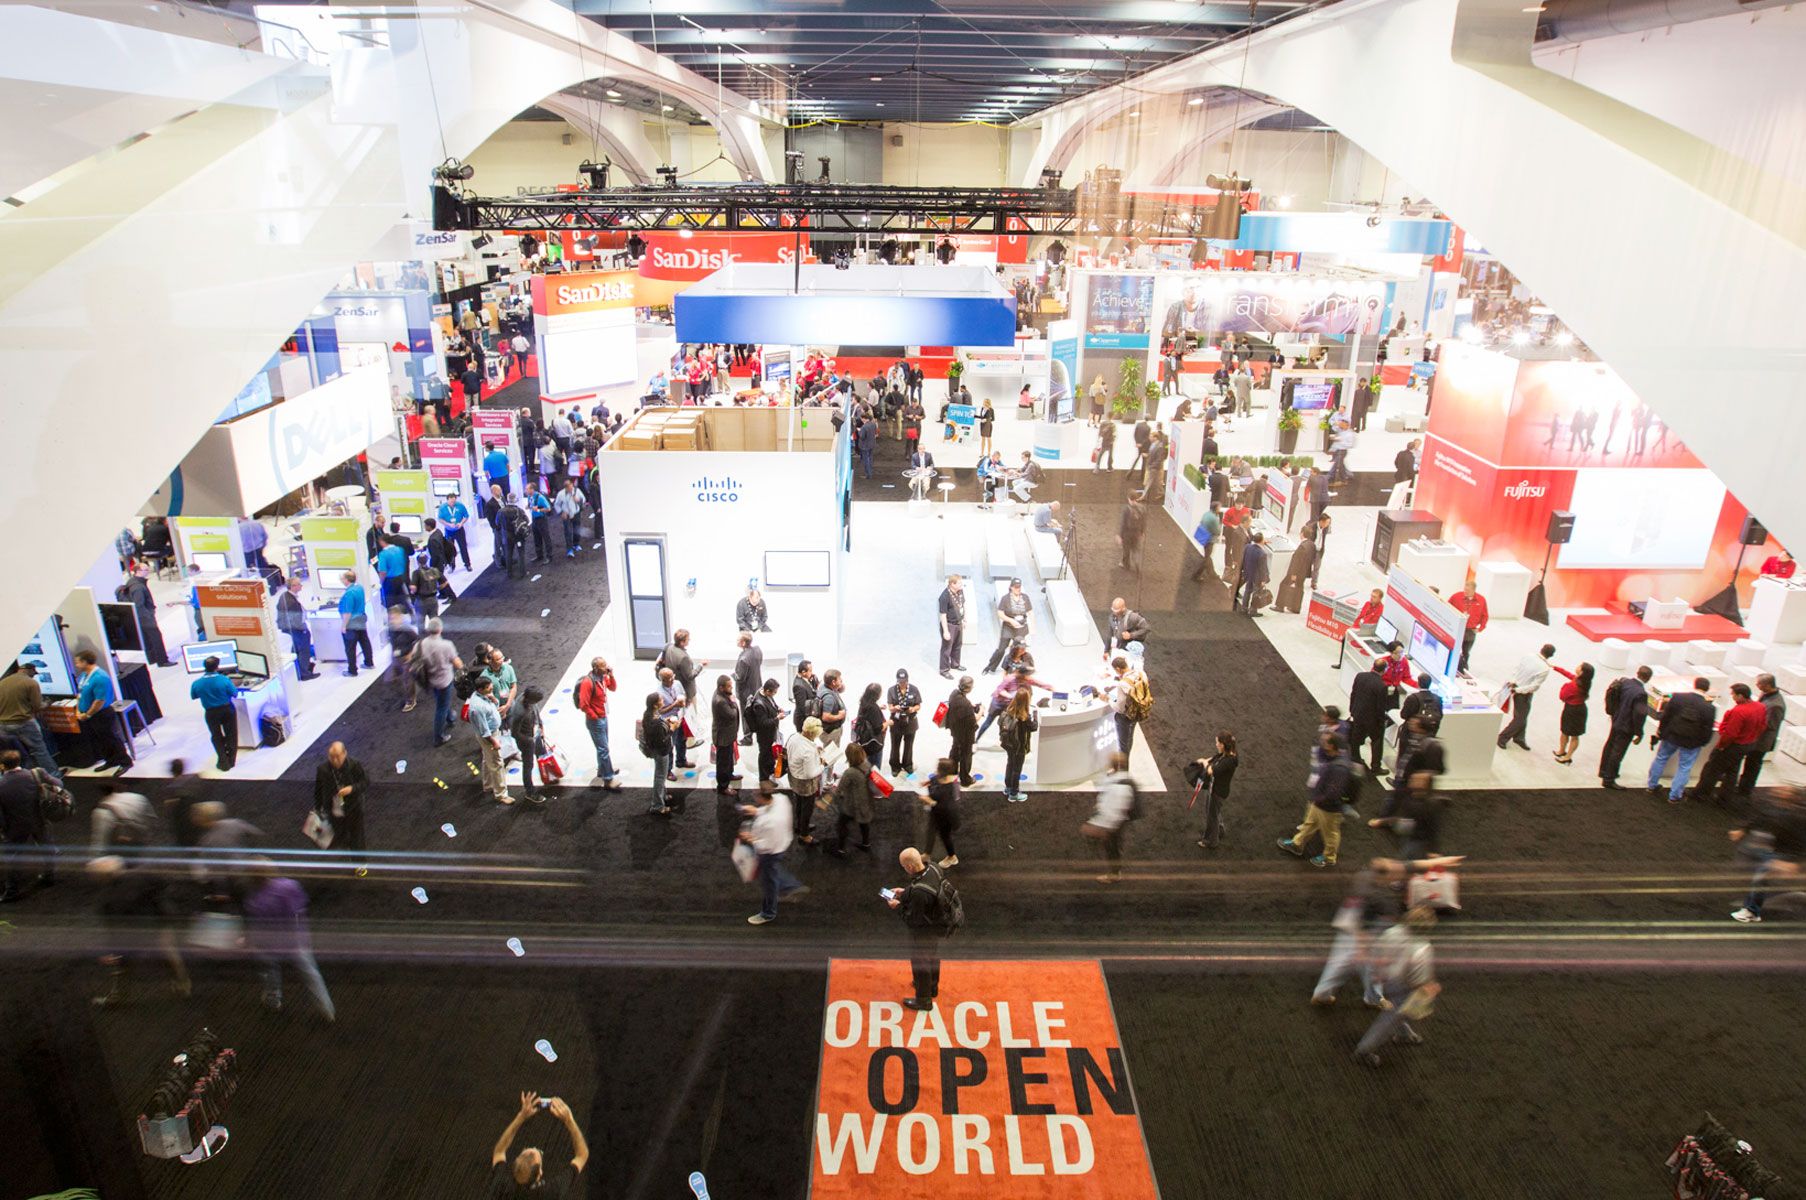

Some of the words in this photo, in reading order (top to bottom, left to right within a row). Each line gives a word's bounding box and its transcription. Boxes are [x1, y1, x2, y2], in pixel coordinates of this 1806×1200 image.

[416, 231, 457, 246] ZenSar
[653, 247, 742, 270] SanDisk
[558, 280, 635, 306] SanDisk
[1092, 294, 1145, 308] Achieve
[334, 305, 380, 318] ZenSar
[697, 492, 739, 503] CISCO
[1504, 480, 1545, 501] FUJITSU
[215, 593, 248, 601] solutions
[824, 1000, 1072, 1049] ORACLE
[867, 1046, 1136, 1116] OPEN
[817, 1112, 1095, 1176] WORLD
